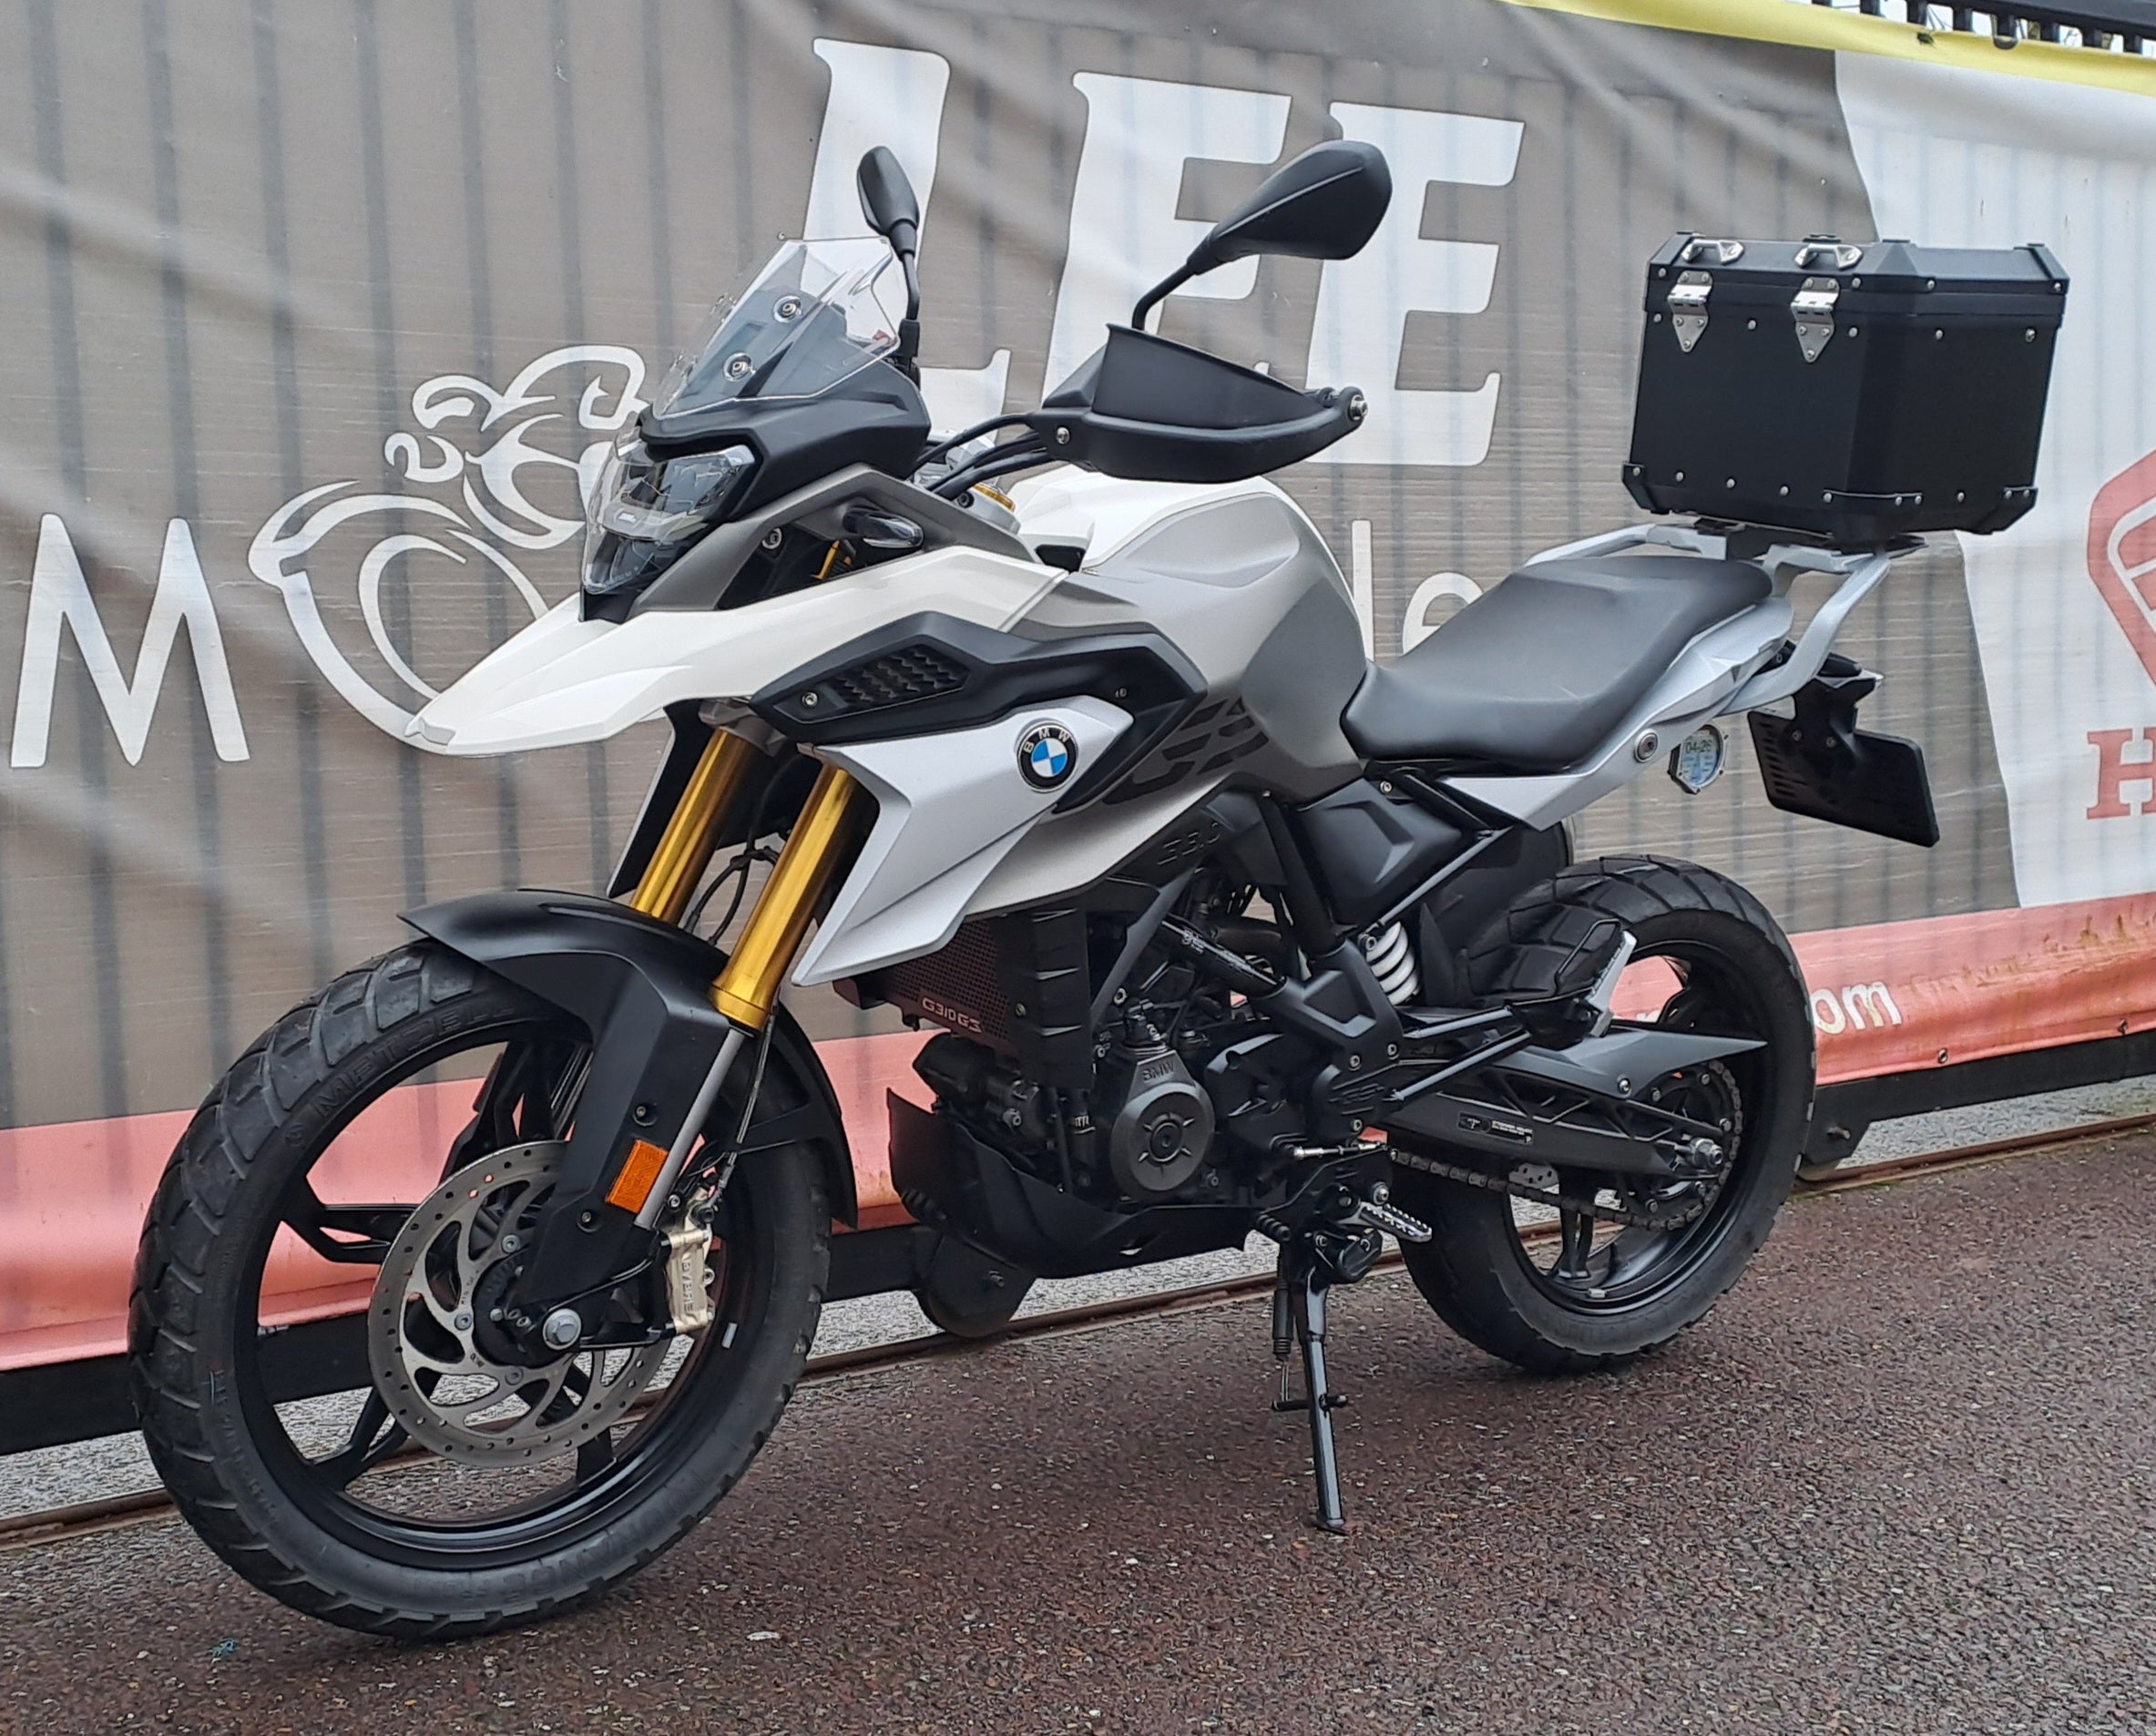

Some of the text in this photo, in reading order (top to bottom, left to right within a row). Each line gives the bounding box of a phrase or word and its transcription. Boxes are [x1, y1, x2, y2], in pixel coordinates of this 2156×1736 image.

[791, 38, 1526, 468] LEE
[1022, 727, 1071, 753] BMW
[312, 1004, 521, 1120] METZELE
[1141, 1059, 1175, 1081] BMW
